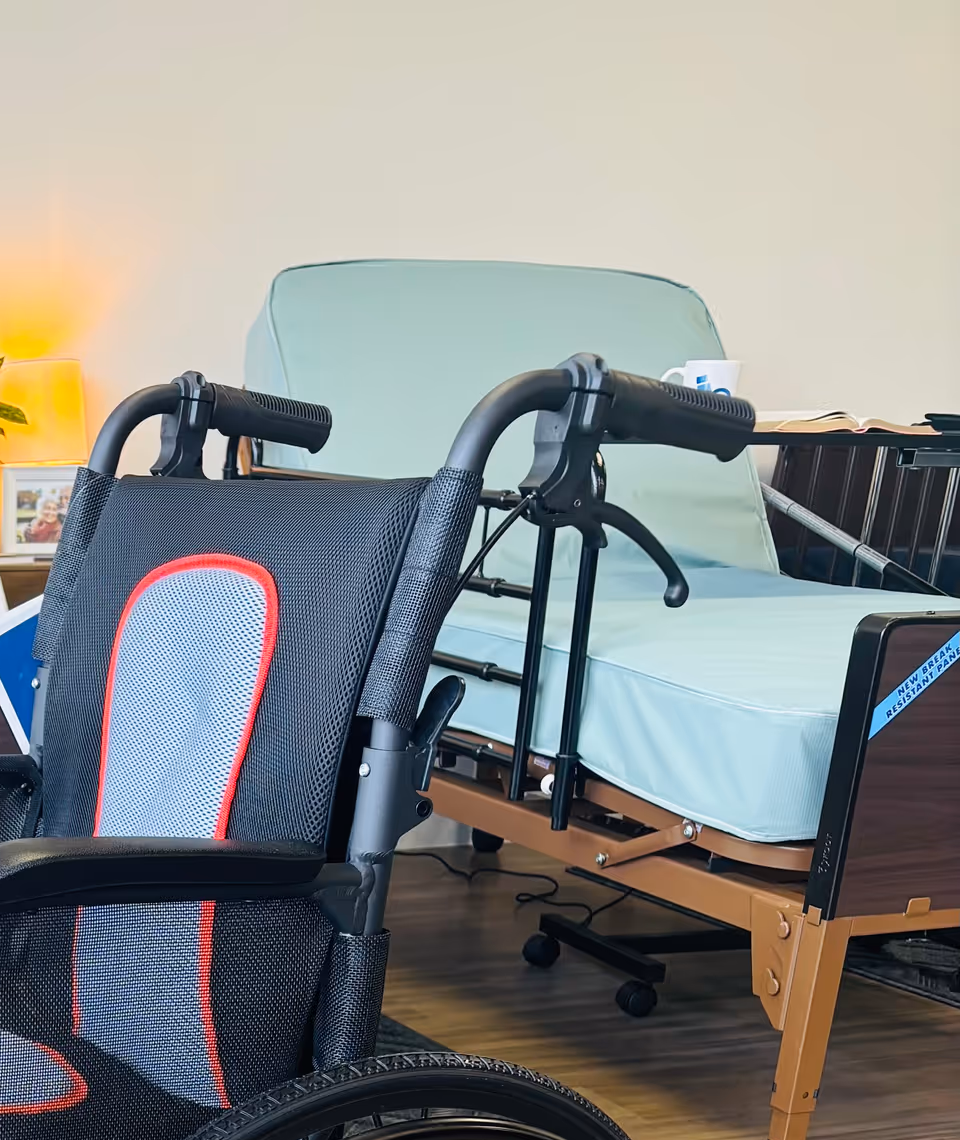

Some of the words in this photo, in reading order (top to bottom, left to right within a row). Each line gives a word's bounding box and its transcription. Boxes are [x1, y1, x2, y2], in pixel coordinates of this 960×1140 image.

[885, 671, 934, 718] RESISTANT
[897, 674, 919, 697] NEW
[921, 643, 952, 675] BREAK
